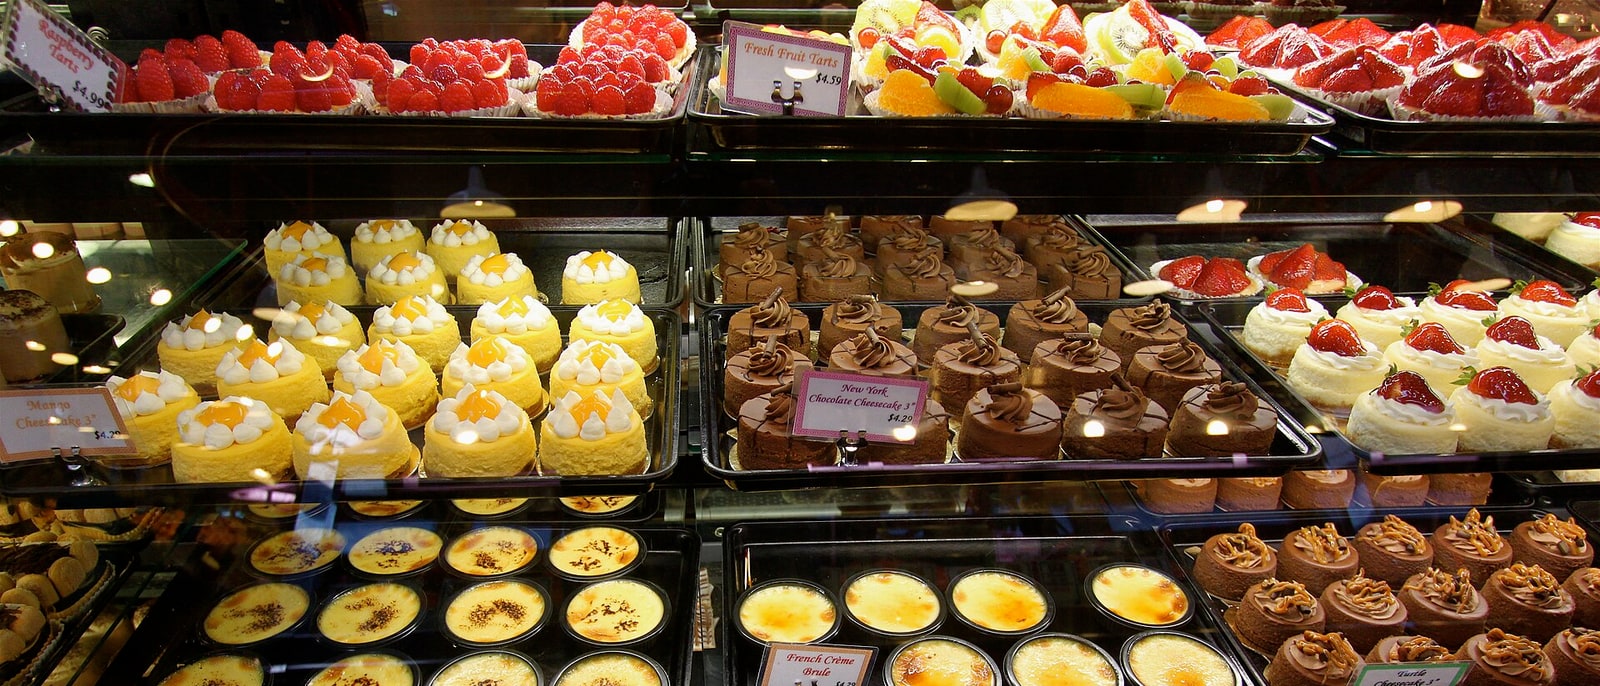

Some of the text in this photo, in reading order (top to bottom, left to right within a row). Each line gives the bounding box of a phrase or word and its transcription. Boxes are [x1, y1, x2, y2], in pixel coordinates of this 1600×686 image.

[39, 19, 94, 70] Raspberry
[49, 44, 79, 73] Tarts
[745, 42, 838, 68] Fresh Fruit Tarts
[816, 73, 841, 85] $4.59
[73, 80, 104, 108] $4.99
[841, 384, 888, 397] New York
[26, 400, 70, 412] Mango
[809, 394, 916, 411] Chocolate Cheesecake 3"
[16, 416, 81, 429] Cheesake
[888, 413, 912, 422] $4.29
[787, 653, 855, 665] French Crème
[803, 667, 831, 676] Brule
[1397, 669, 1427, 677] Turtle
